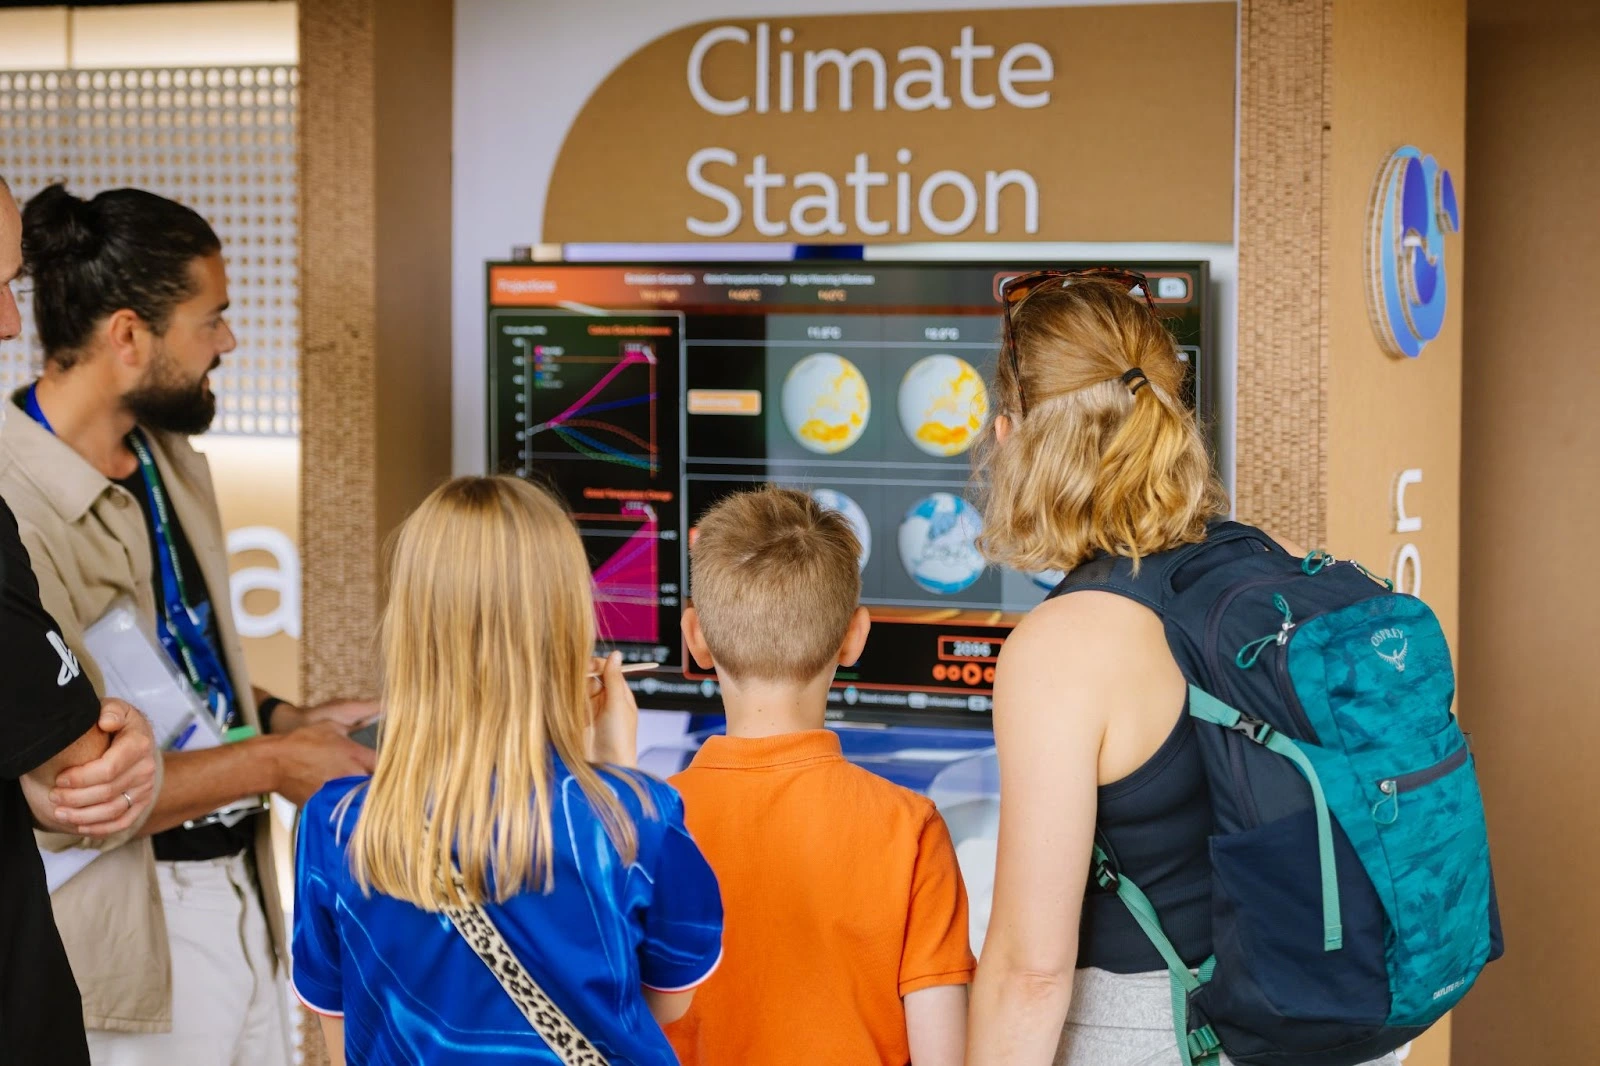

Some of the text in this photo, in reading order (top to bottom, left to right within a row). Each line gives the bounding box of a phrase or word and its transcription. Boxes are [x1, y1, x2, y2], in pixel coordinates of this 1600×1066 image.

[686, 22, 1054, 115] Climate
[686, 147, 1039, 236] Station
[1370, 628, 1404, 647] OSPREY
